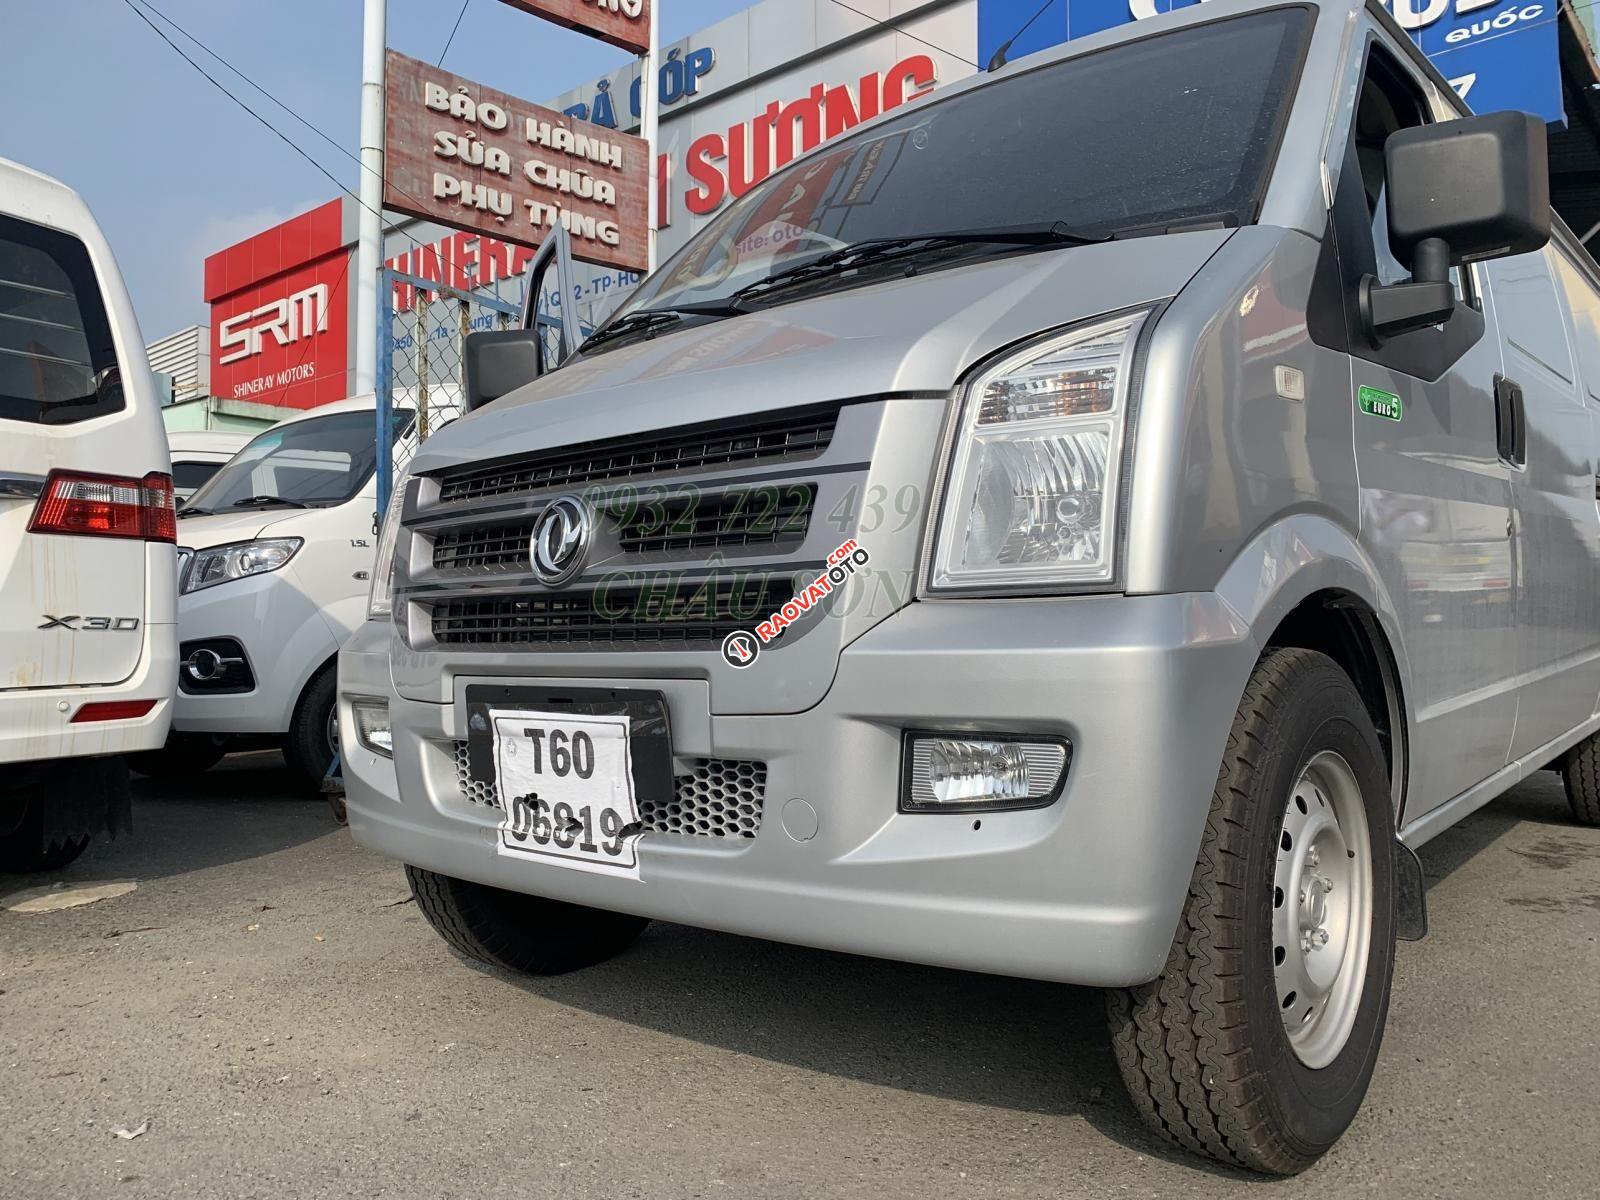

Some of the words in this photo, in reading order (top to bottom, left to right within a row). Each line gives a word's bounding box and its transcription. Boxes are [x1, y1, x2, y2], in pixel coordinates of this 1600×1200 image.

[1445, 5, 1544, 43] QUỐC
[425, 82, 507, 131] BẢO
[526, 117, 622, 169] HÀNH
[434, 130, 511, 176] SỬA
[434, 172, 513, 223] PHỤ
[524, 199, 620, 246] TÙNG
[220, 283, 328, 365] SRM
[233, 375, 275, 398] SHINERAY
[276, 362, 315, 386] MOTORS
[37, 614, 140, 630] X30
[524, 728, 595, 780] T60
[511, 796, 625, 857] 06819
